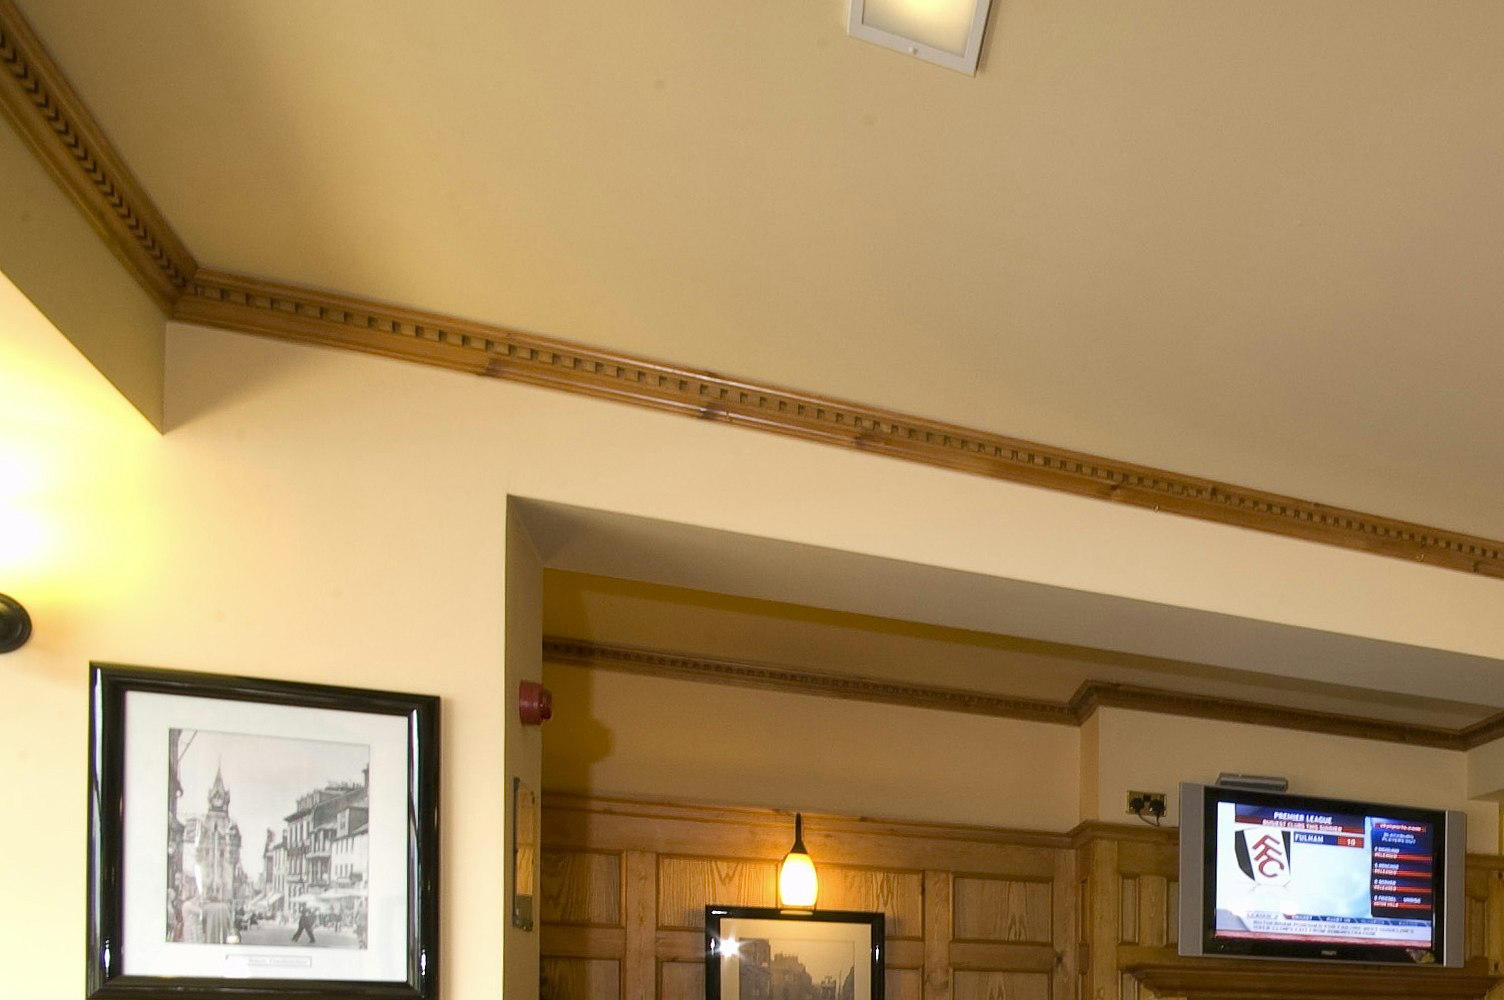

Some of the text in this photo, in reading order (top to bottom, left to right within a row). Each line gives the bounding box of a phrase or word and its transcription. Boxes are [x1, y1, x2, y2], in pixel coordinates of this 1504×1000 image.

[1273, 811, 1333, 825] PREMIER LEAGUE
[1295, 833, 1356, 846] FULHAM 10
